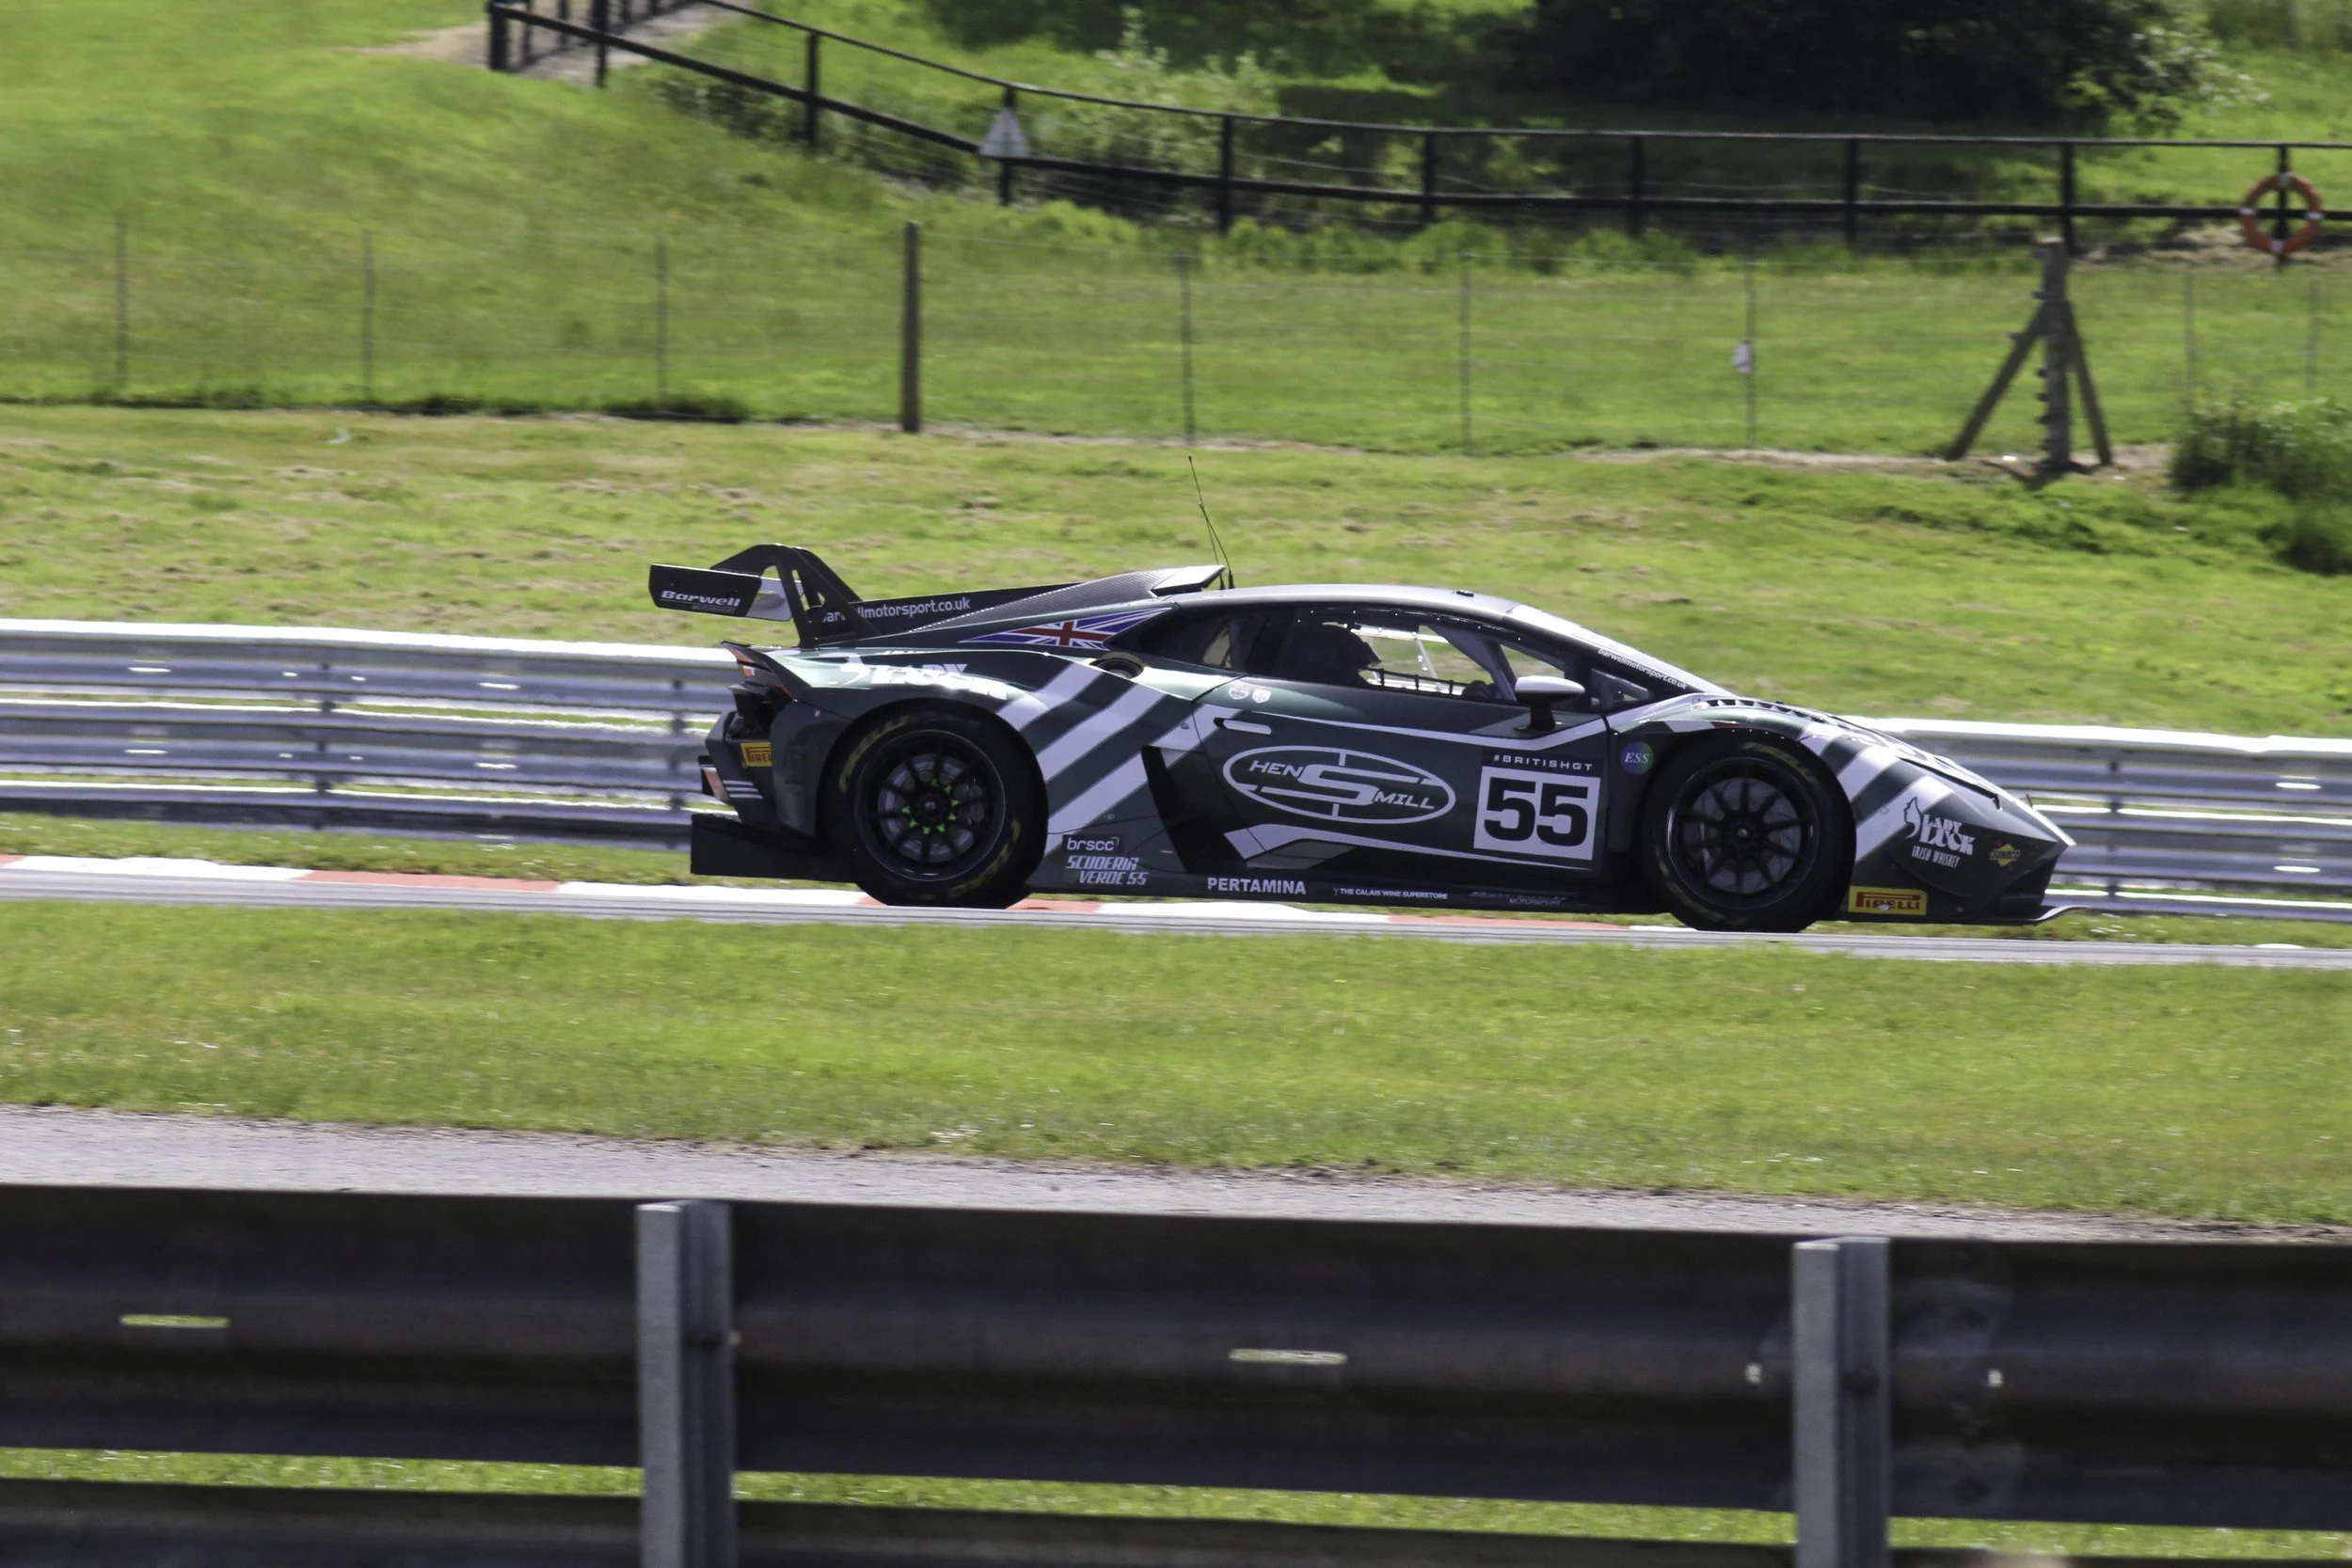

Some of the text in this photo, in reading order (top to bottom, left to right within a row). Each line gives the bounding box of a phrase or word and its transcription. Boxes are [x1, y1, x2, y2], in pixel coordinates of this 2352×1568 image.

[660, 590, 741, 607] Barwell
[1597, 648, 1689, 689] barwellmotorsport.co.uk
[1494, 754, 1594, 771] #BRITISHGT
[1624, 752, 1649, 764] ESS
[1484, 777, 1589, 847] 55
[1067, 837, 1115, 851] brscc
[1919, 827, 1976, 855] LUCK
[1911, 845, 1932, 862] IRISH
[1066, 855, 1139, 871] SCUDERIA
[1079, 871, 1126, 884] VERDE
[1207, 877, 1307, 895] PERTAMINA
[1402, 891, 1448, 899] SUPERSTORE
